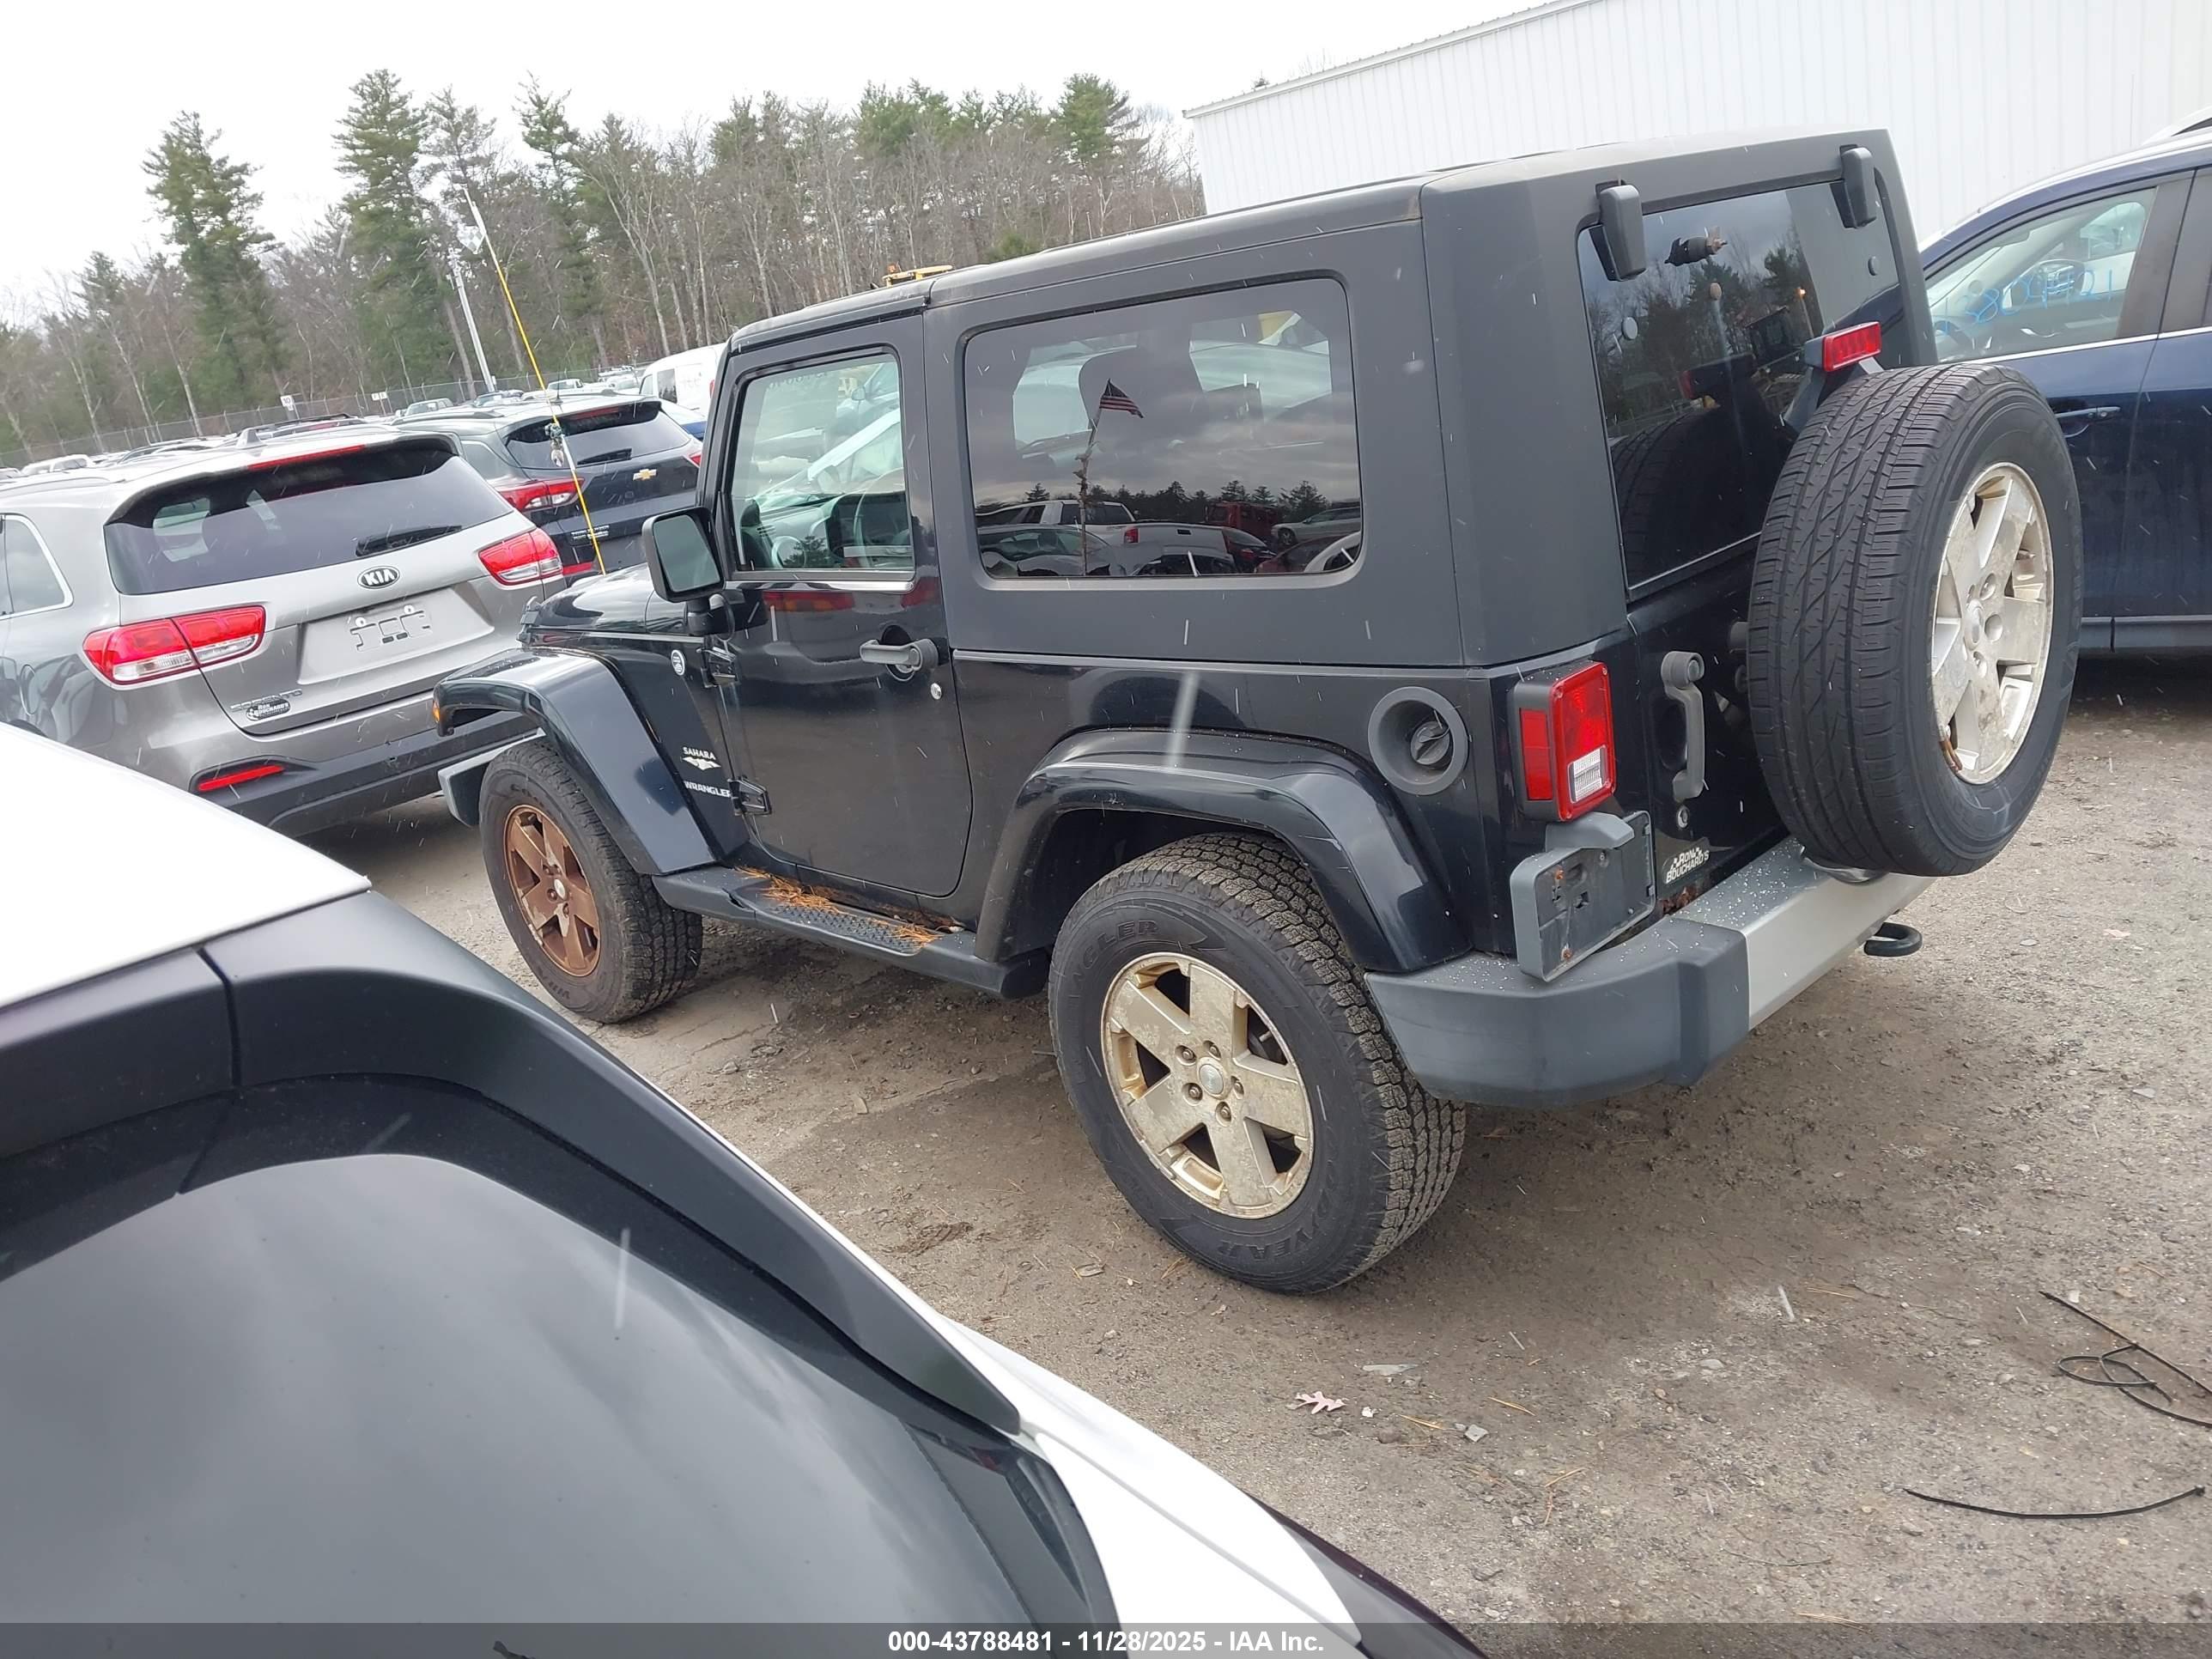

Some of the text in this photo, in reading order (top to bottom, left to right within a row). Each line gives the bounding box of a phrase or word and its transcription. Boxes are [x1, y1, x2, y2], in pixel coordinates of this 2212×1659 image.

[363, 568, 396, 586] KIA
[683, 746, 716, 761] SAHARA
[1679, 848, 1696, 865] RON
[1666, 849, 1710, 884] BOUCHARD'S
